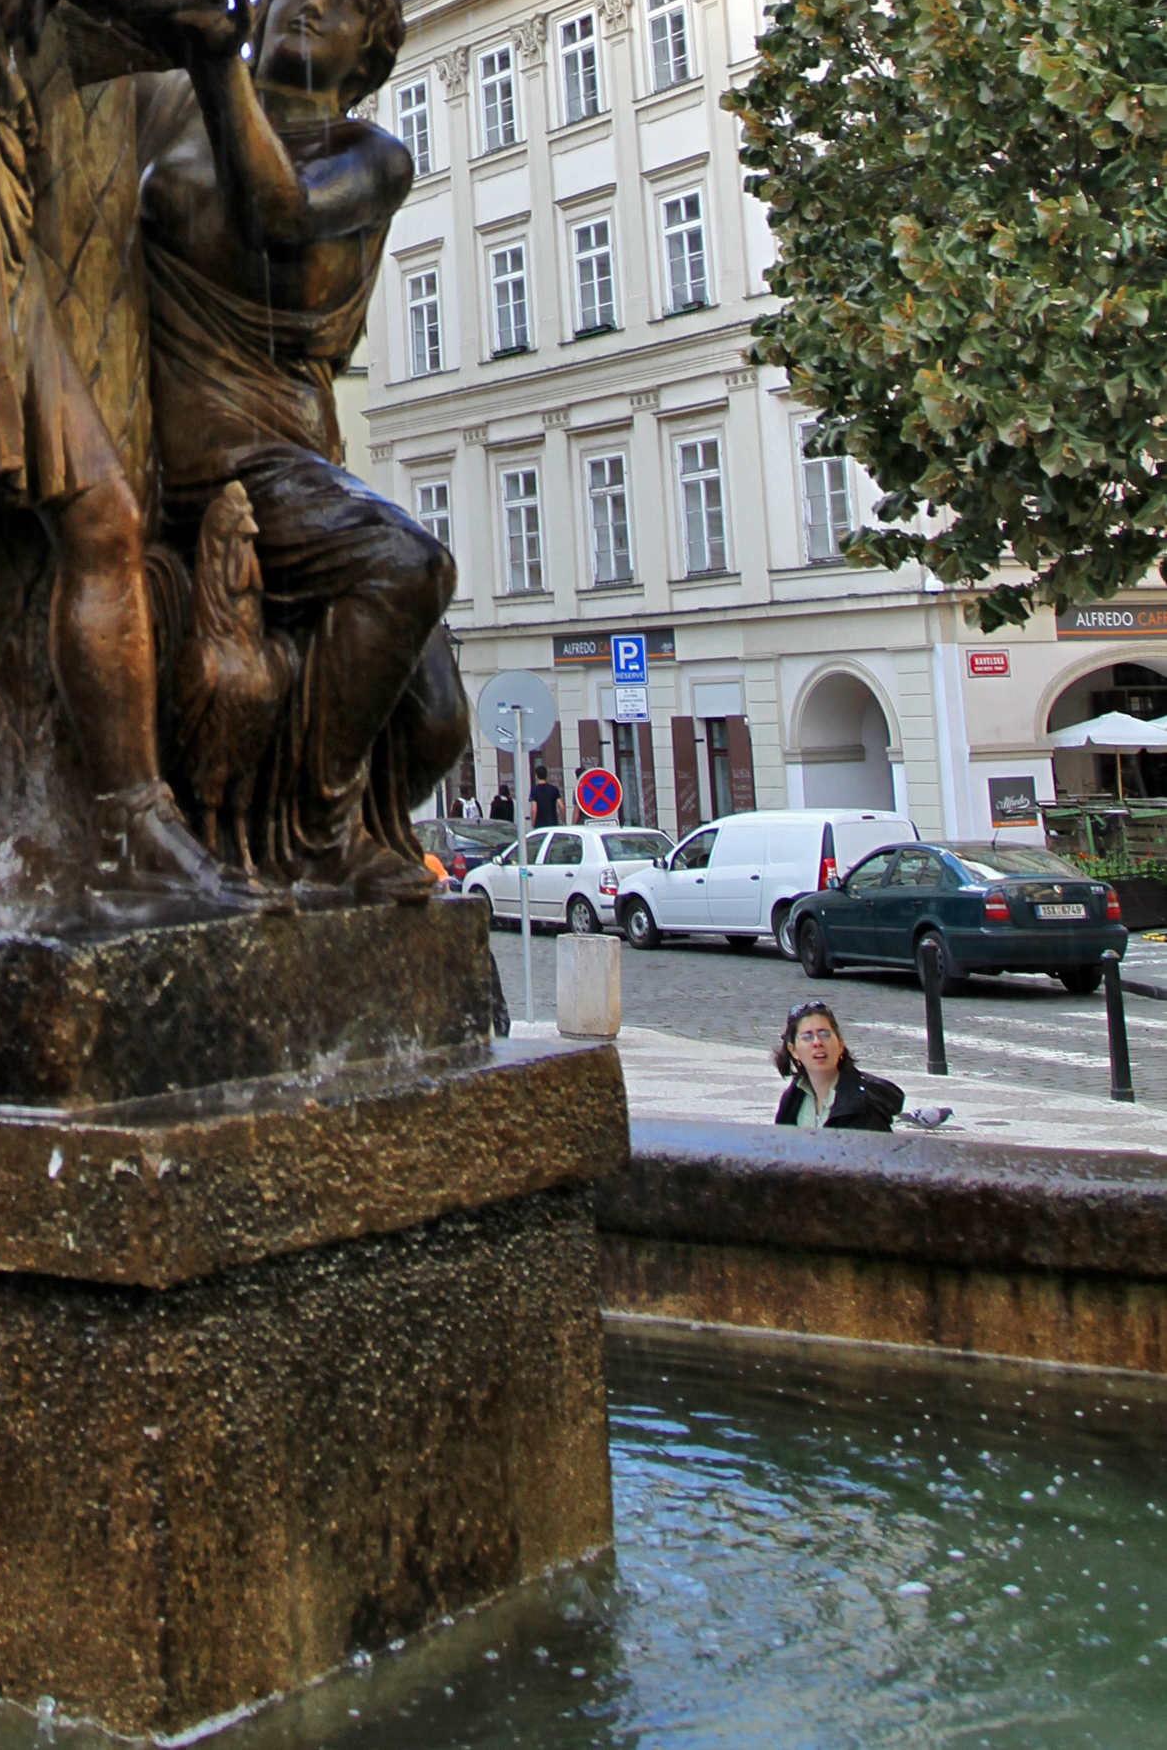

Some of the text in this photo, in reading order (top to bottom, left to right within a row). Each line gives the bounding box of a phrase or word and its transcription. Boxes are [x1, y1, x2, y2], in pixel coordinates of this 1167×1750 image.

[1076, 611, 1134, 627] ALFREDO
[563, 641, 597, 655] ALFREDO
[618, 641, 639, 670] P
[1061, 905, 1082, 915] 6749
